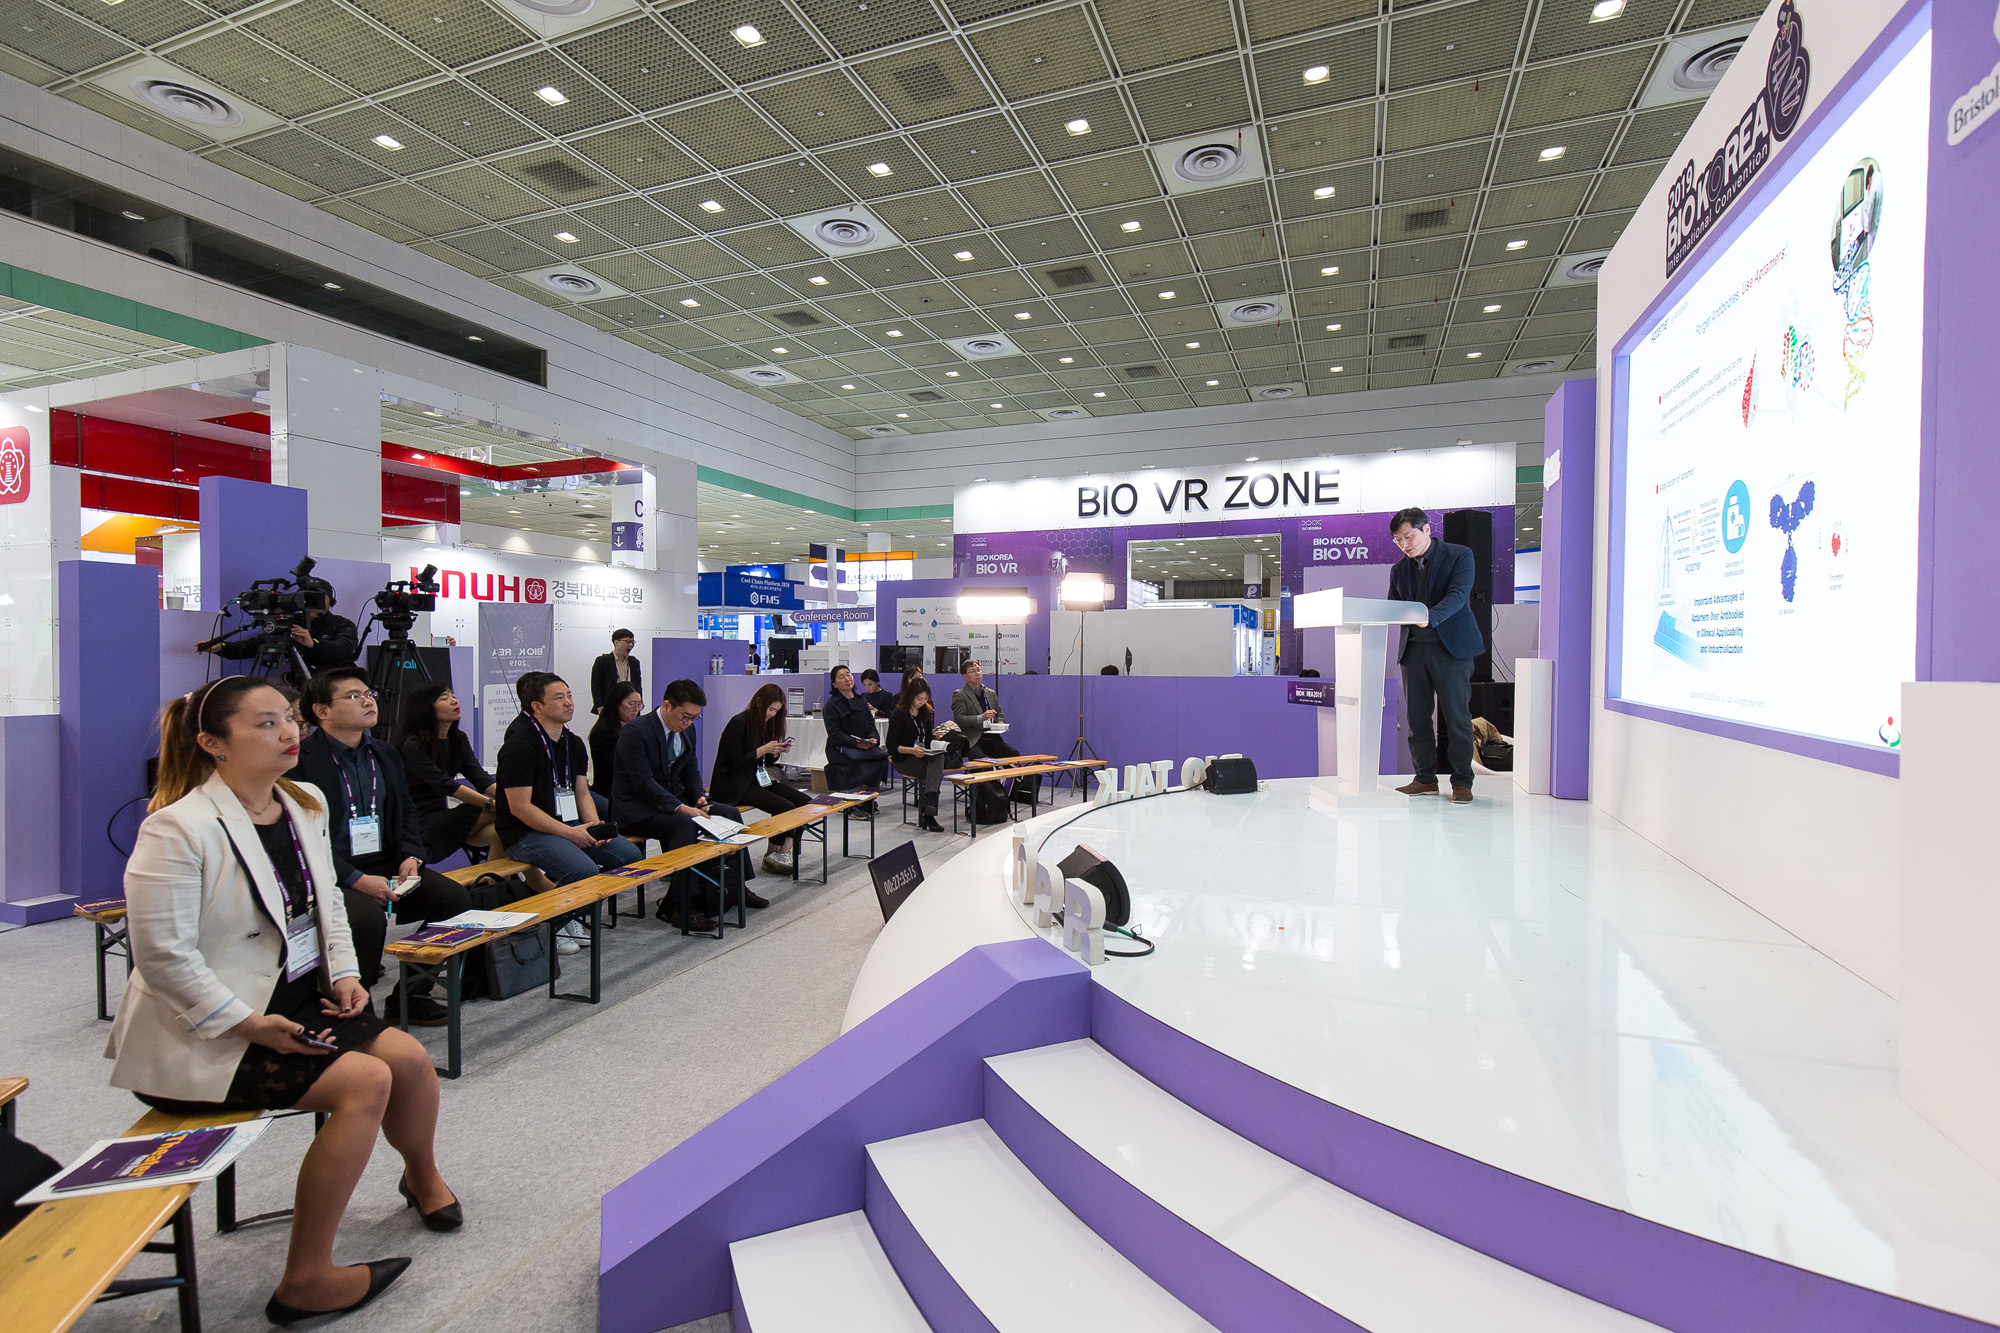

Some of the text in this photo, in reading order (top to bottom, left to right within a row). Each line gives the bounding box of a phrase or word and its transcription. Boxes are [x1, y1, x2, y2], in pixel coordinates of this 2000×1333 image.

[1669, 165, 1693, 217] 2019
[1667, 143, 1768, 274] International Convention
[1078, 469, 1340, 518] BIO VR ZONE
[1313, 546, 1369, 561] BIO VR
[976, 562, 1018, 575] BIO VR
[552, 580, 643, 604] 경북대학교병원
[760, 595, 780, 605] FMS
[794, 611, 869, 622] Conference Room
[128, 1133, 188, 1178] Theater
